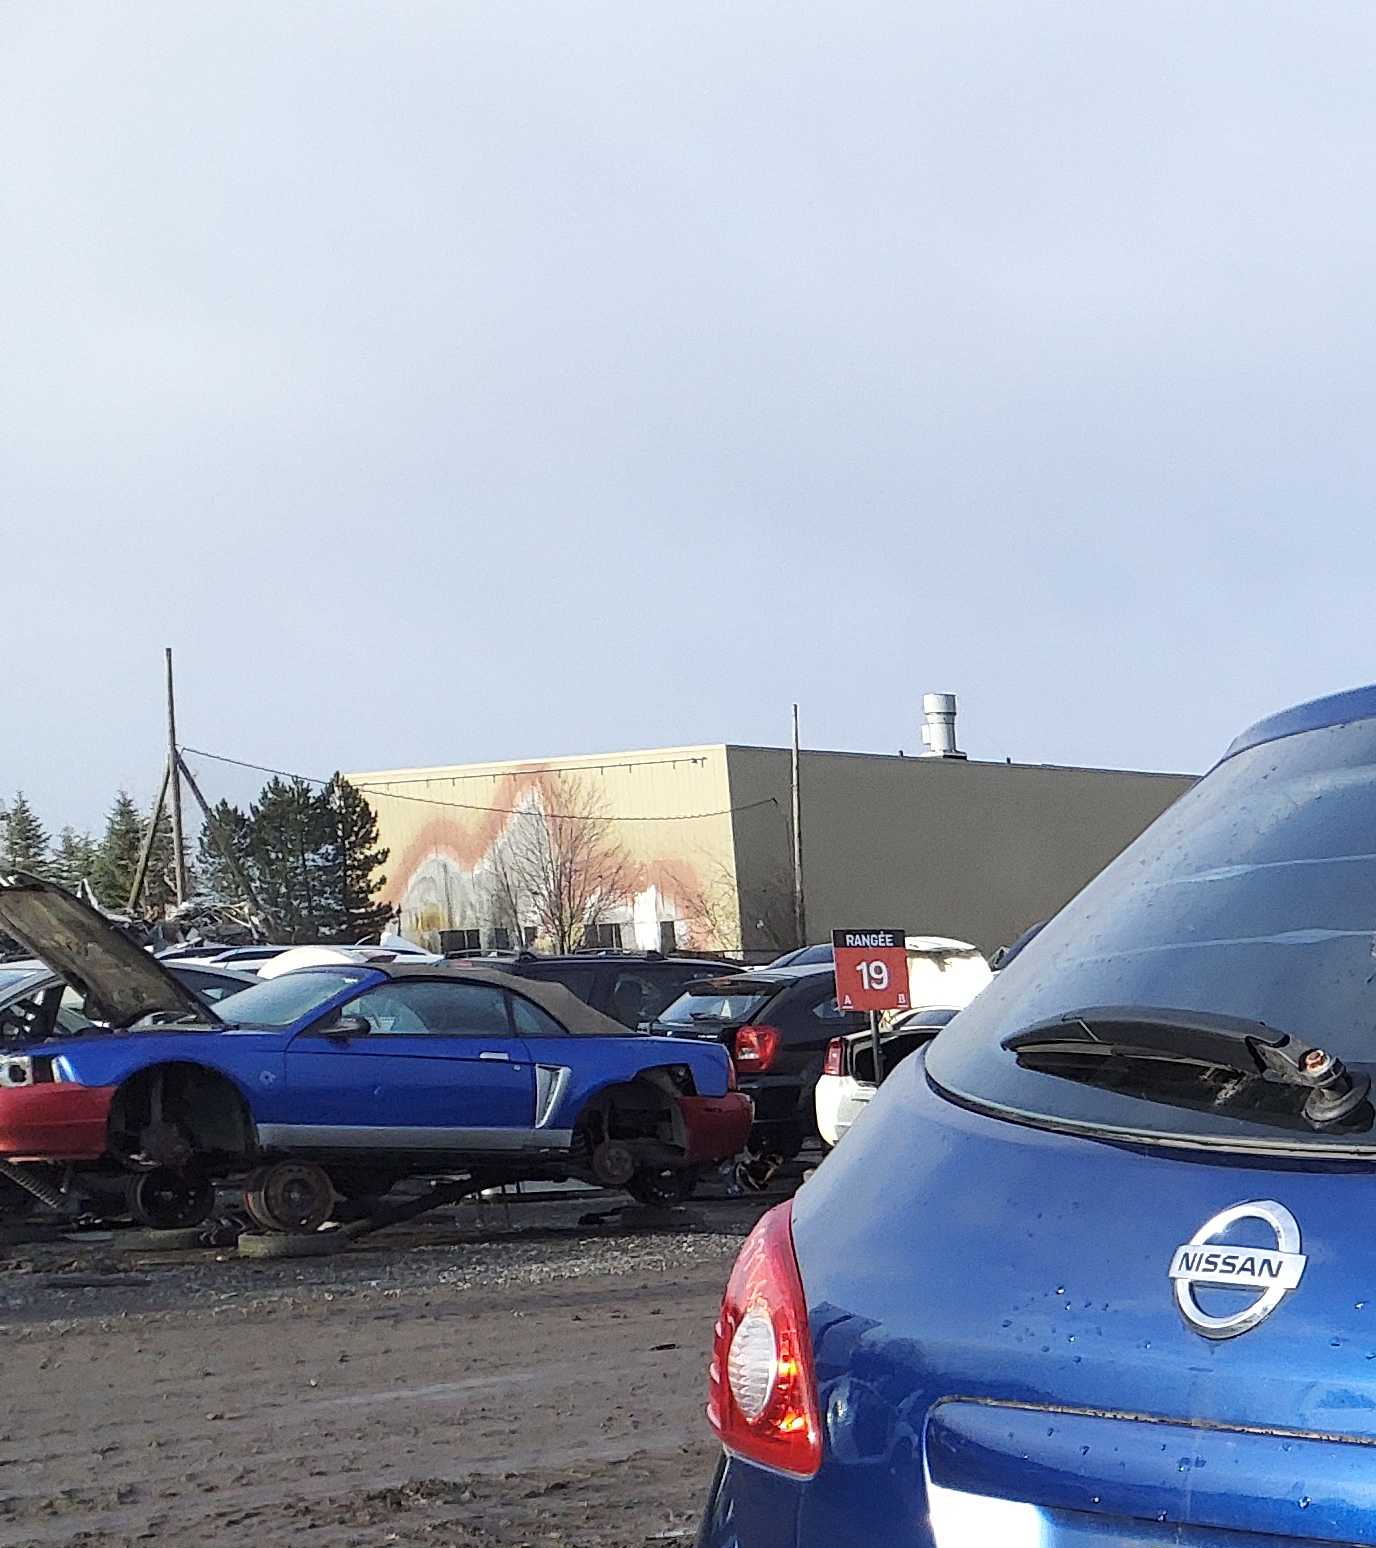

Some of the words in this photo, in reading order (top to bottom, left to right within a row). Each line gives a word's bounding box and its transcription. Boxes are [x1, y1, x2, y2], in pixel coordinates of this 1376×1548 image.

[845, 931, 894, 947] RANGÉE
[856, 960, 889, 990] 19
[844, 995, 852, 1005] A
[1178, 1252, 1283, 1278] NISSAN
